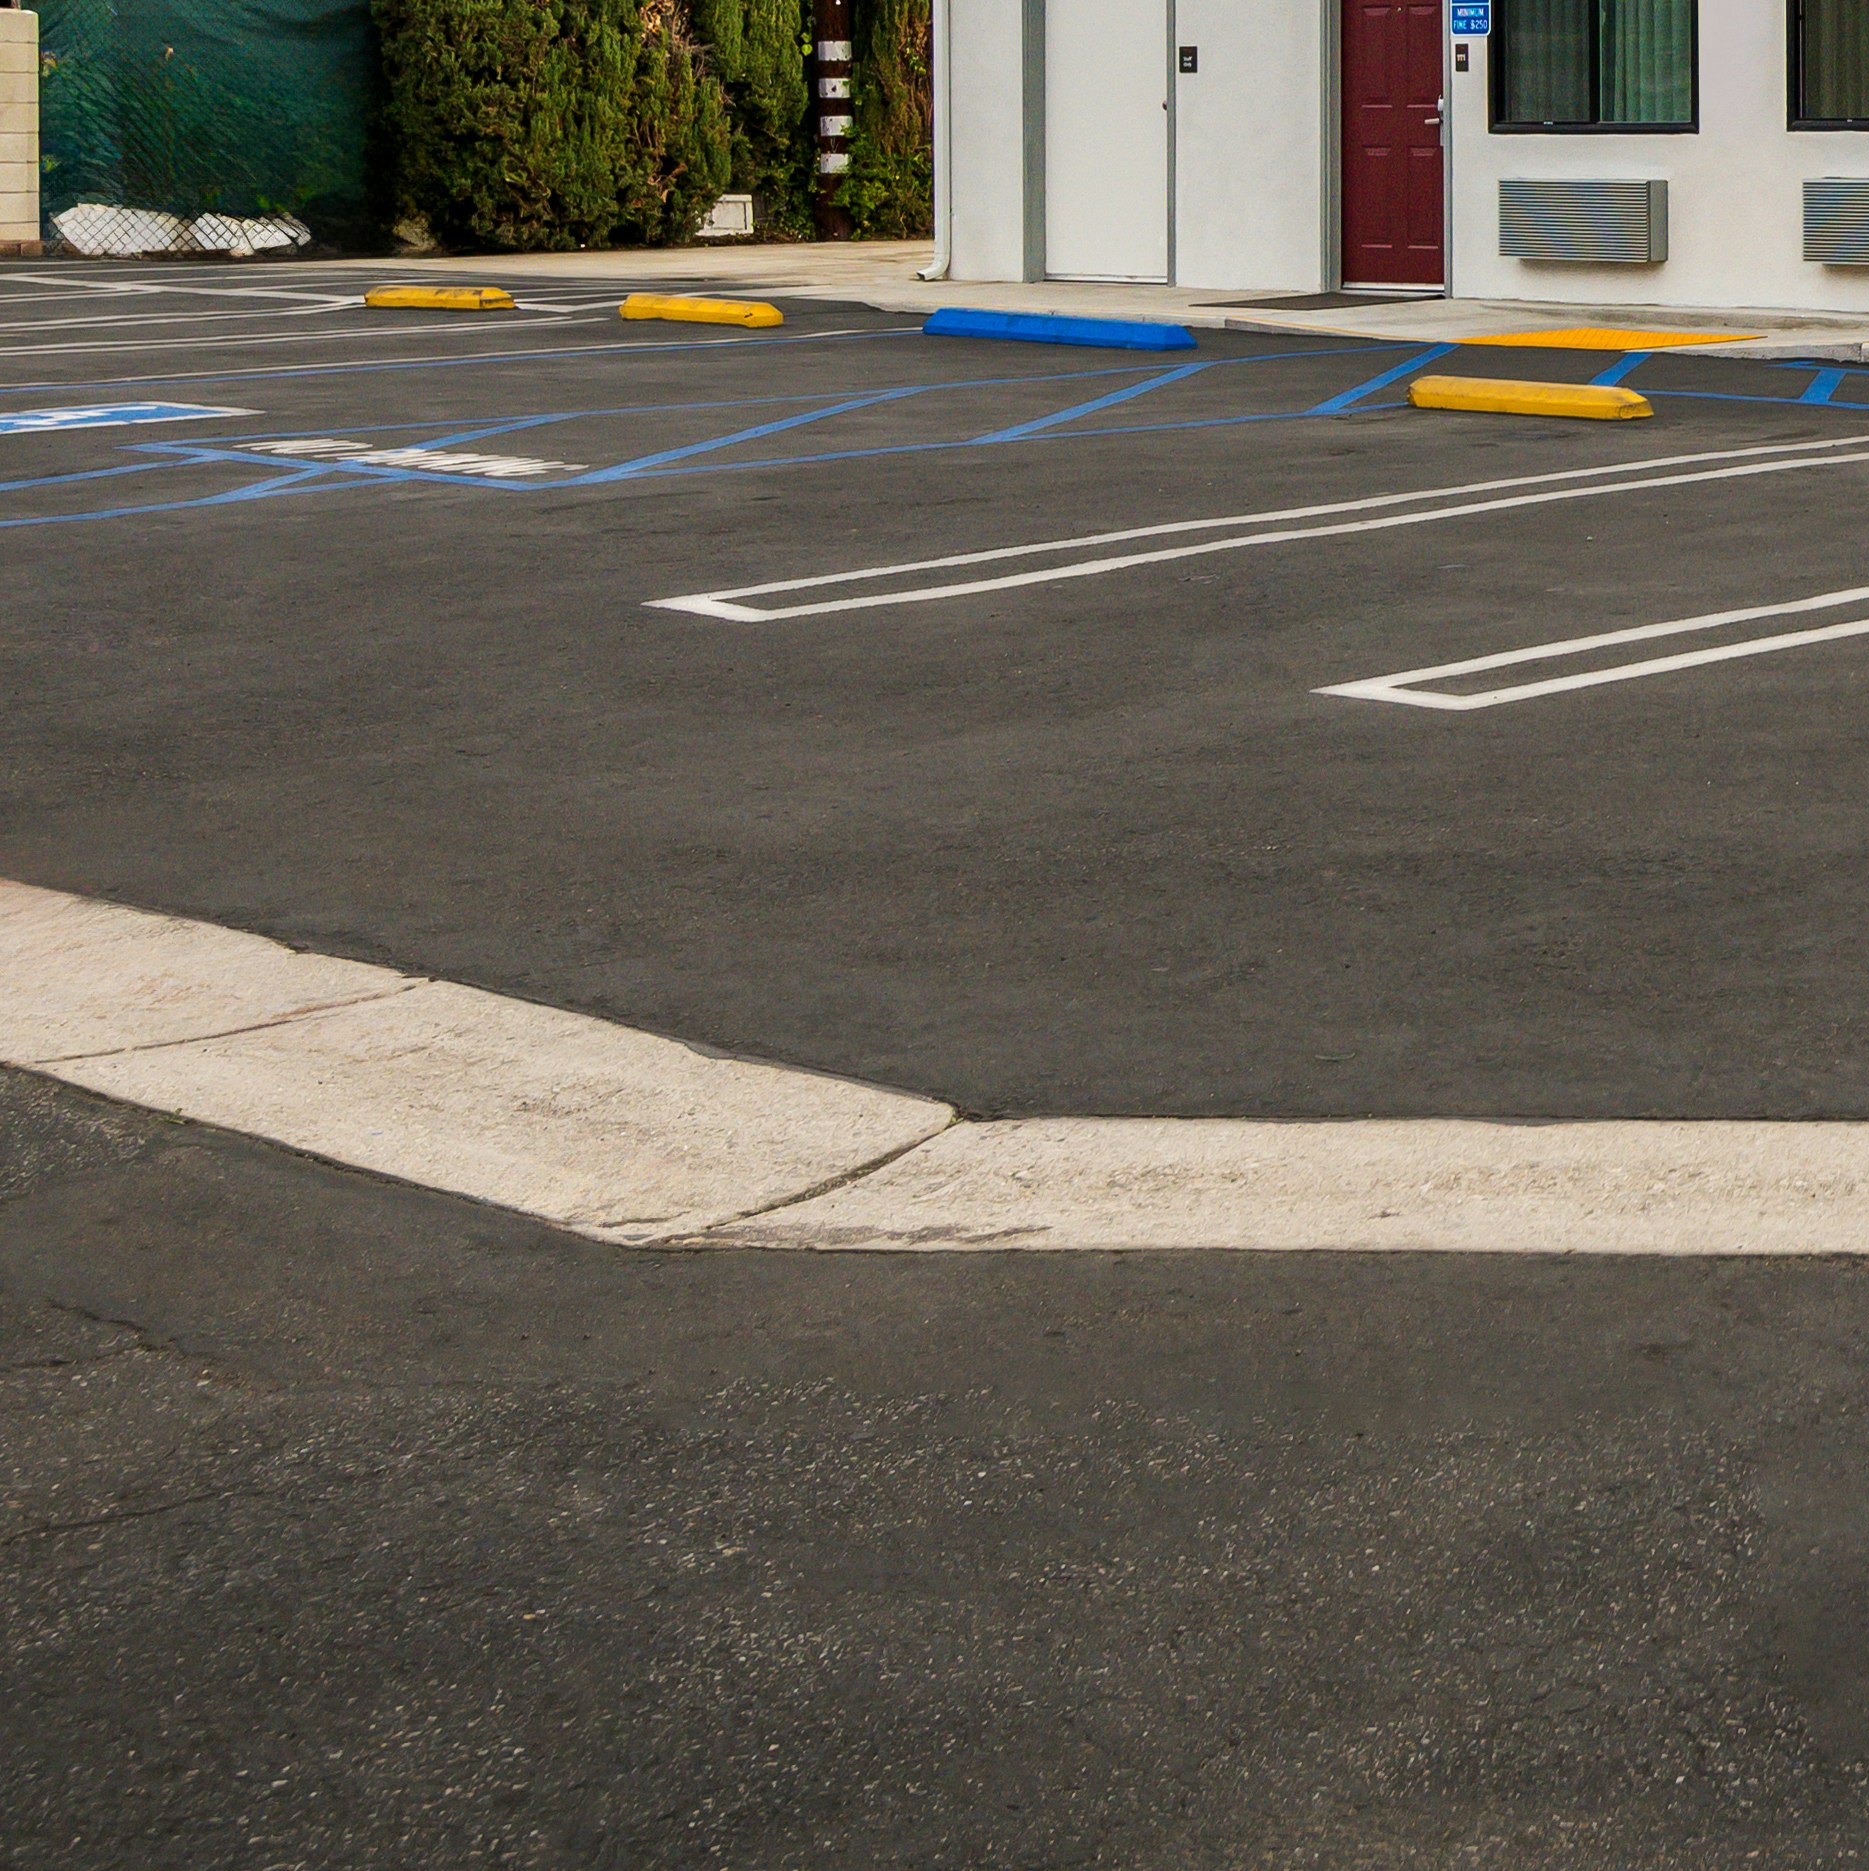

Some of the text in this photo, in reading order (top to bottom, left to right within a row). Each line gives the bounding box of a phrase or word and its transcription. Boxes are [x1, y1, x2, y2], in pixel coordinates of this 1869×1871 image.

[1457, 8, 1484, 17] MINIMUM
[1453, 19, 1488, 30] FINE $250
